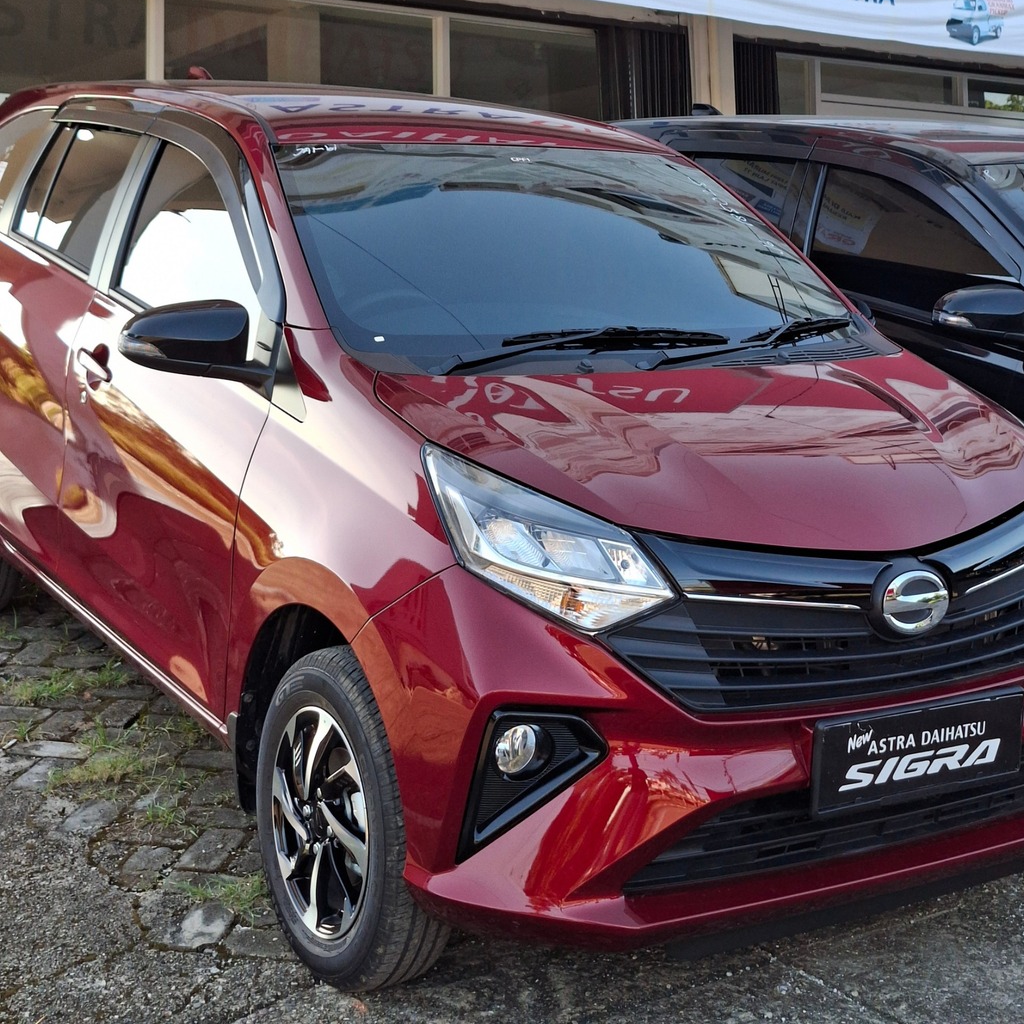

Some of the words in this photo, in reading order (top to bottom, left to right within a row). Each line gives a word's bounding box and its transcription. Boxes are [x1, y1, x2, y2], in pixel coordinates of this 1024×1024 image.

[847, 729, 874, 754] New
[867, 733, 916, 756] ASTRA
[921, 720, 986, 746] DAIHATSU
[838, 738, 1001, 792] SIGRA
